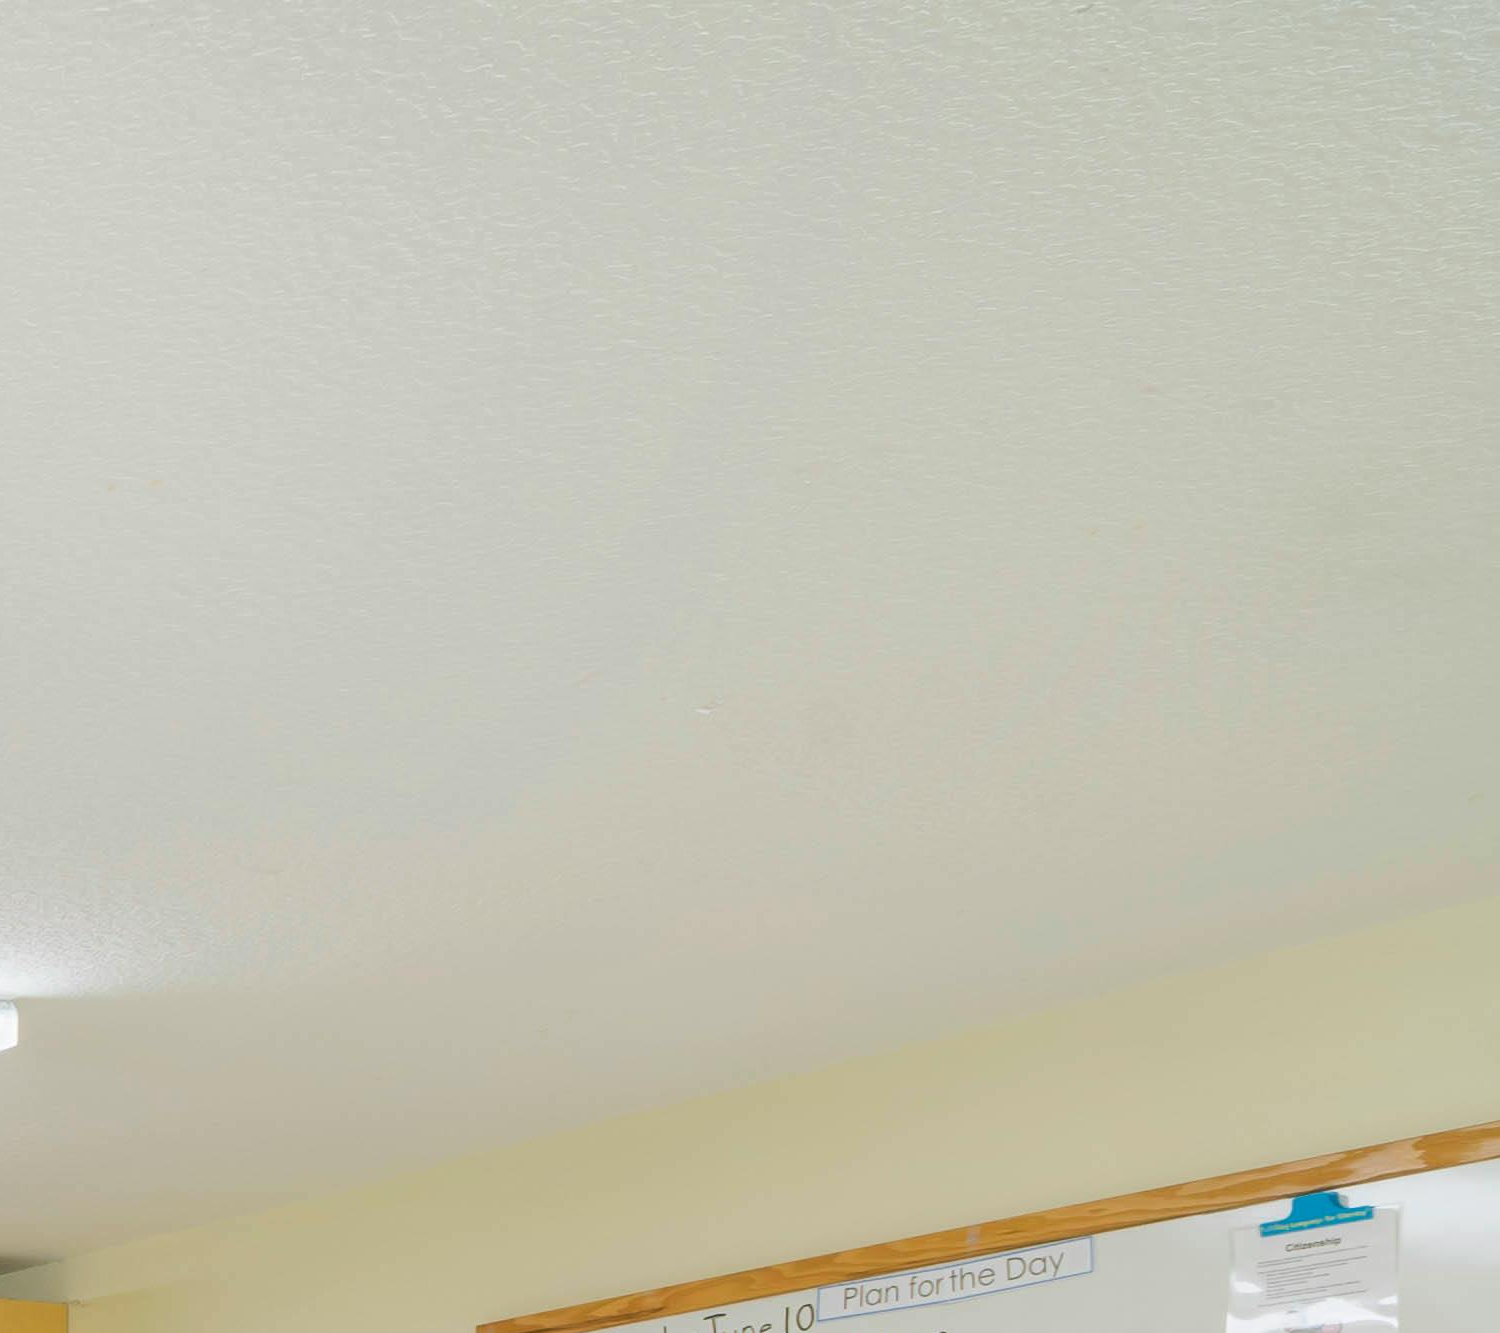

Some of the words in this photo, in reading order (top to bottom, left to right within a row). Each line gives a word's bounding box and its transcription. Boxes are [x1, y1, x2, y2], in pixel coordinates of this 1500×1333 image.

[843, 1284, 899, 1310] Plan
[908, 1274, 942, 1300] for
[949, 1264, 996, 1291] the
[1006, 1251, 1065, 1281] Day
